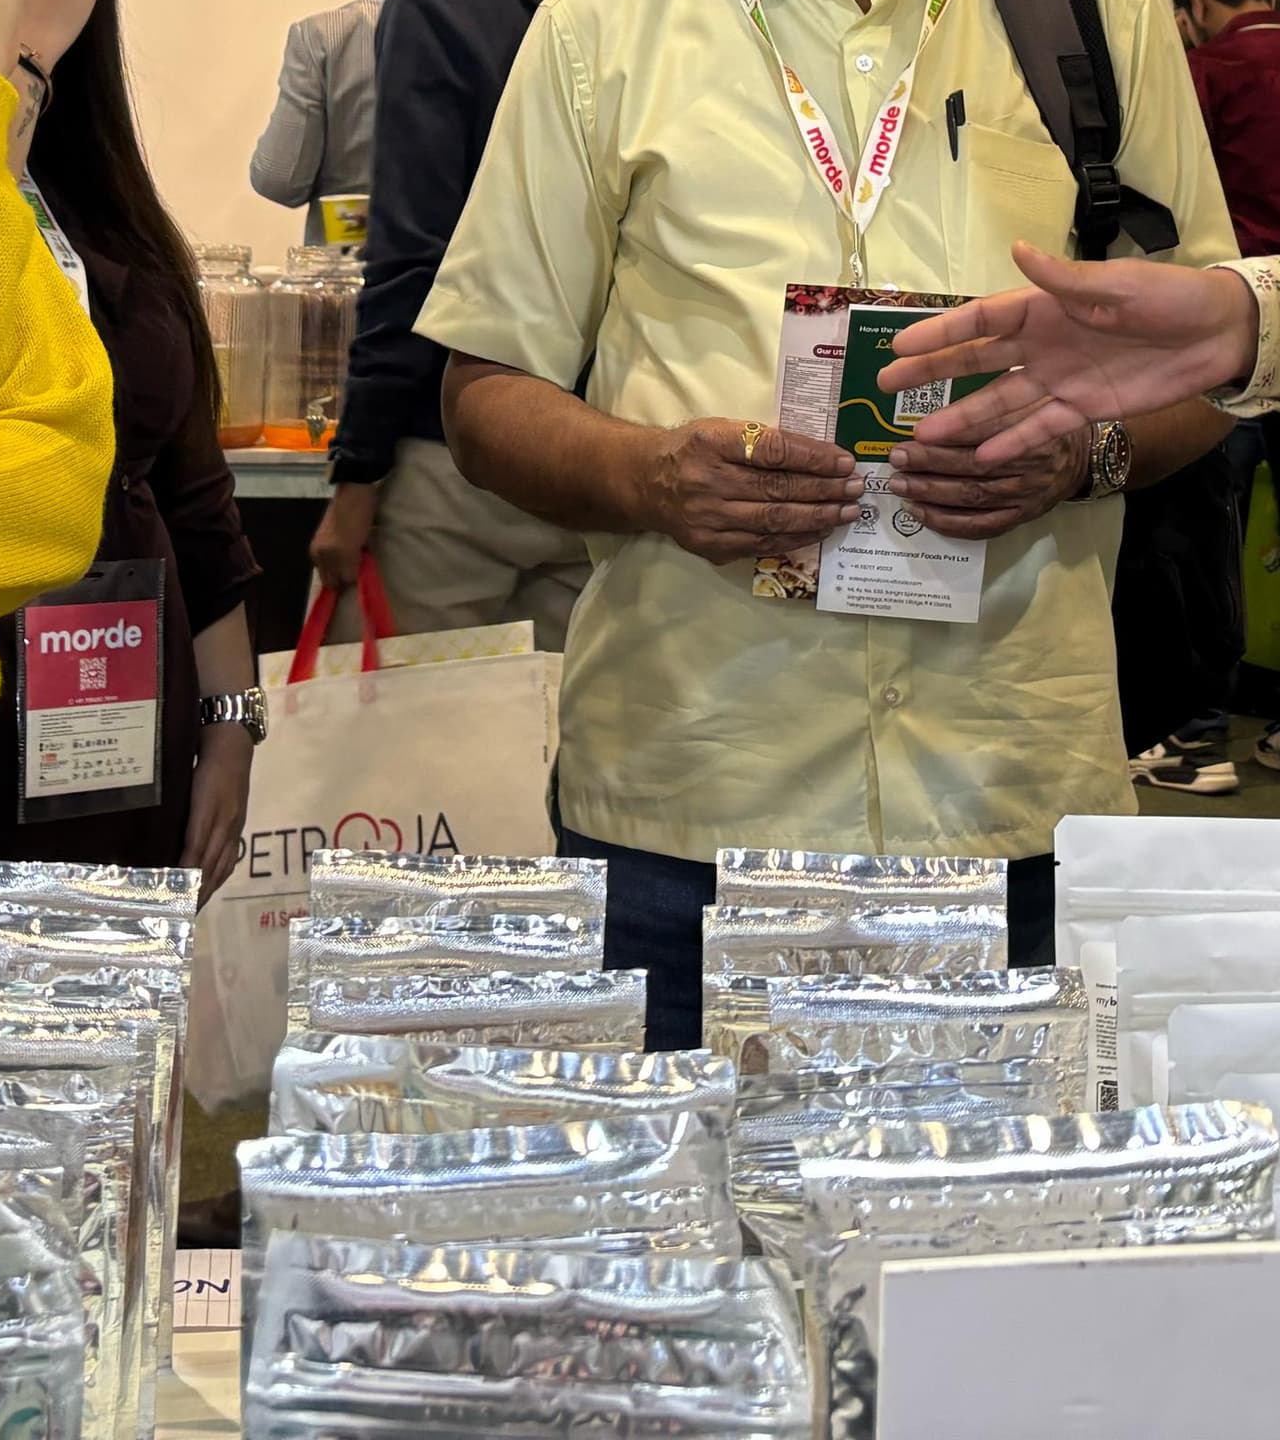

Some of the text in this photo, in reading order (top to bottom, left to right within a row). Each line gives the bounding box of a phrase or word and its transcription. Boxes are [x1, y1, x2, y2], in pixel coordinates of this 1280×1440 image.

[868, 104, 901, 178] morde
[806, 126, 844, 195] morde
[858, 325, 894, 334] Have the
[816, 347, 832, 356] Our
[920, 552, 942, 561] Foods
[943, 554, 956, 562] Pvt
[956, 555, 970, 563] Ltd
[39, 618, 143, 654] morde
